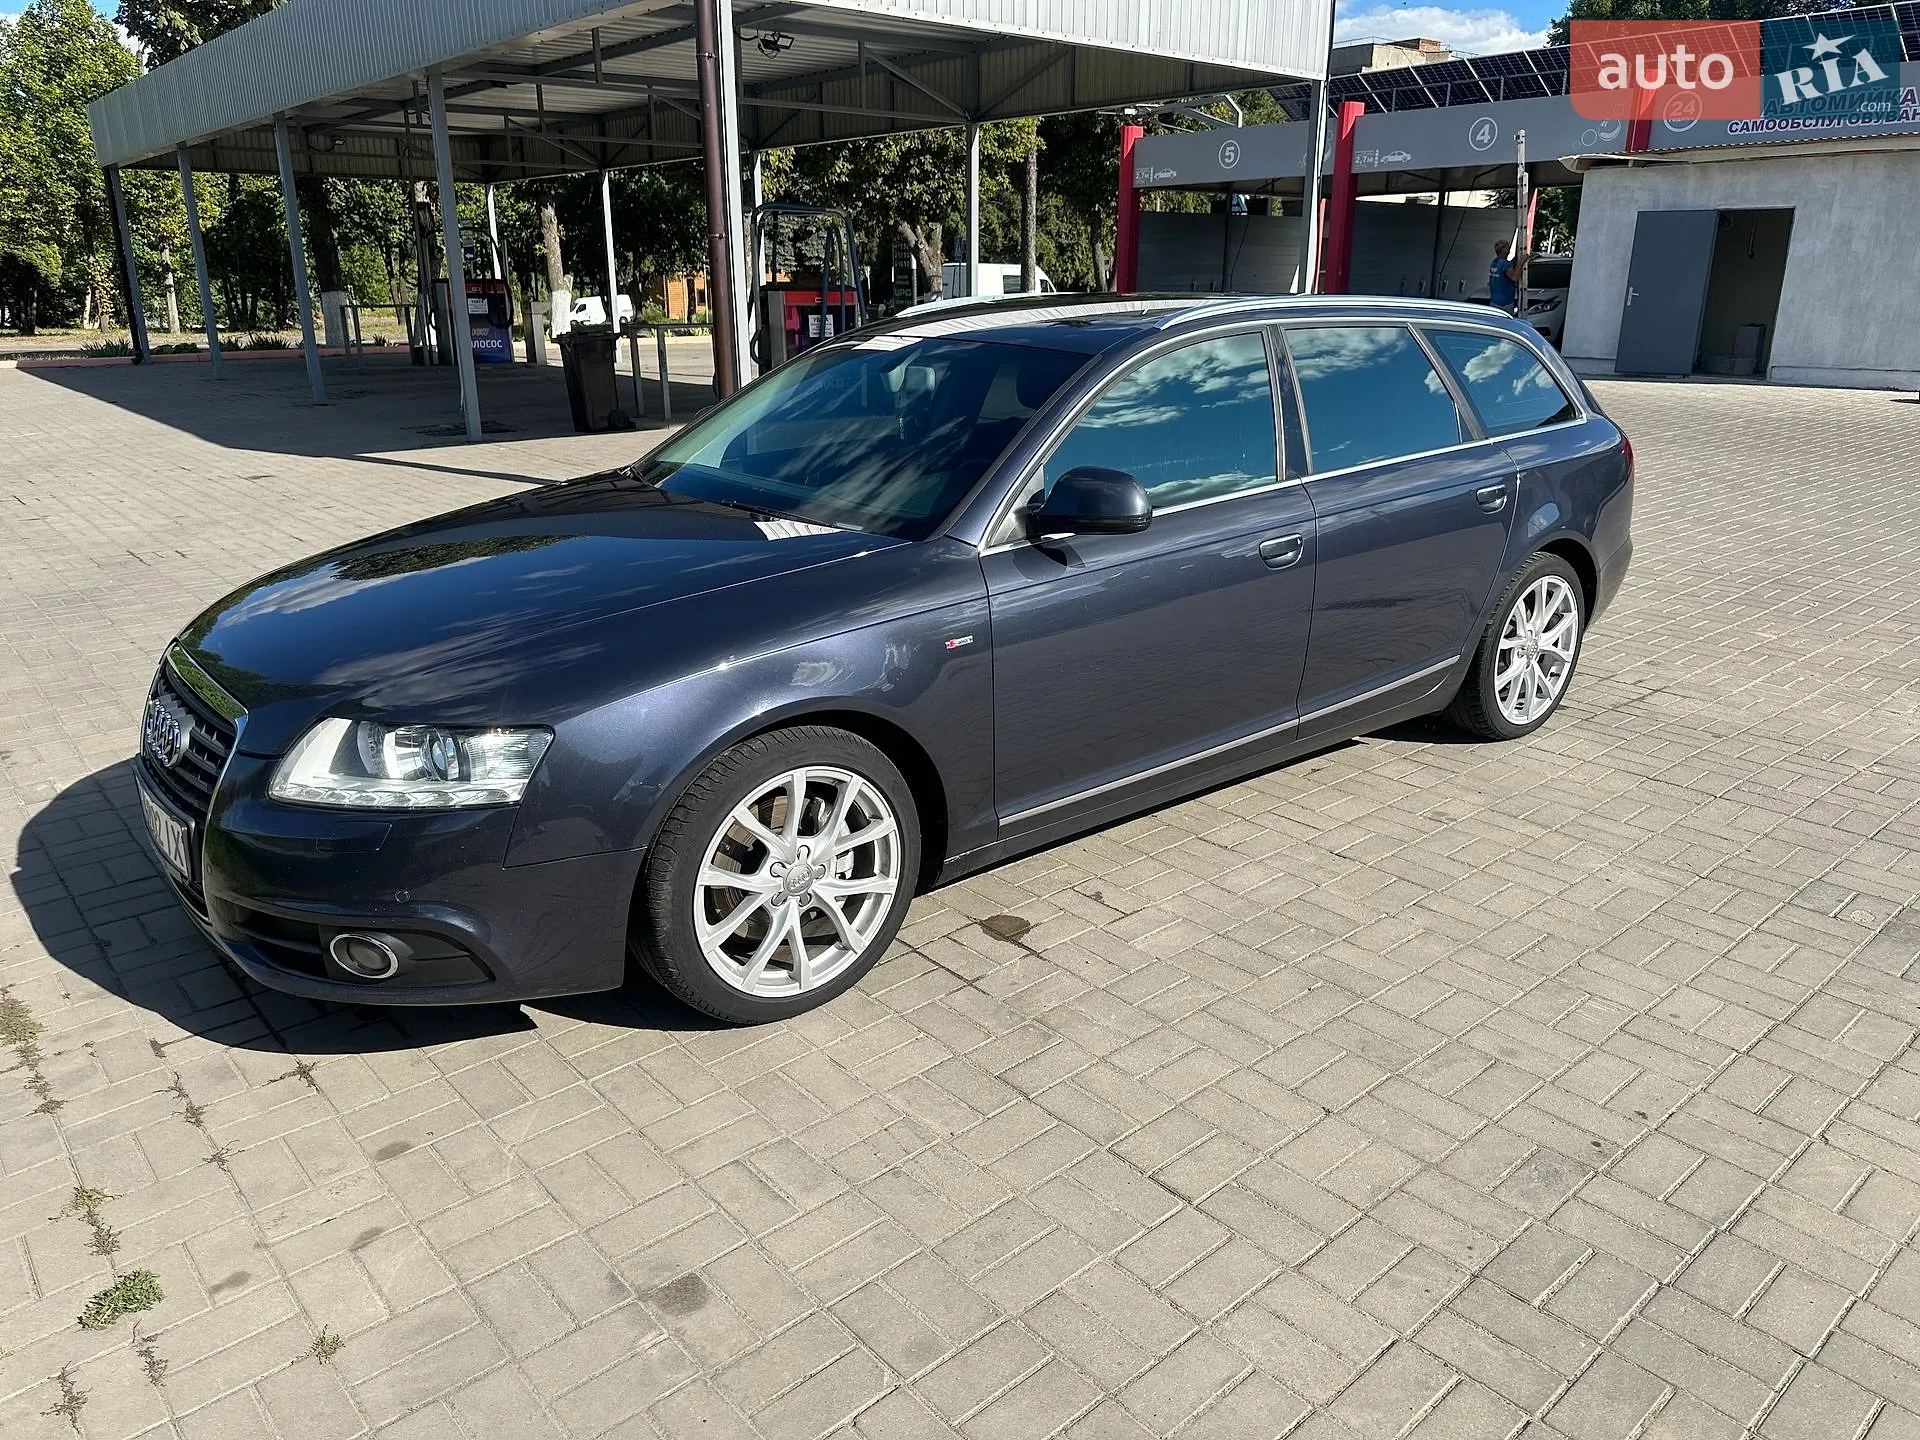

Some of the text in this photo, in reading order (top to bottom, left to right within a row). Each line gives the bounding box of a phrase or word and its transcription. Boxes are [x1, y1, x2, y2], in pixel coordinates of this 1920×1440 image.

[1670, 99, 1696, 117] 24
[1762, 86, 1918, 118] АВТОМИЙКА
[1475, 123, 1491, 144] 4
[1224, 146, 1235, 163] 5
